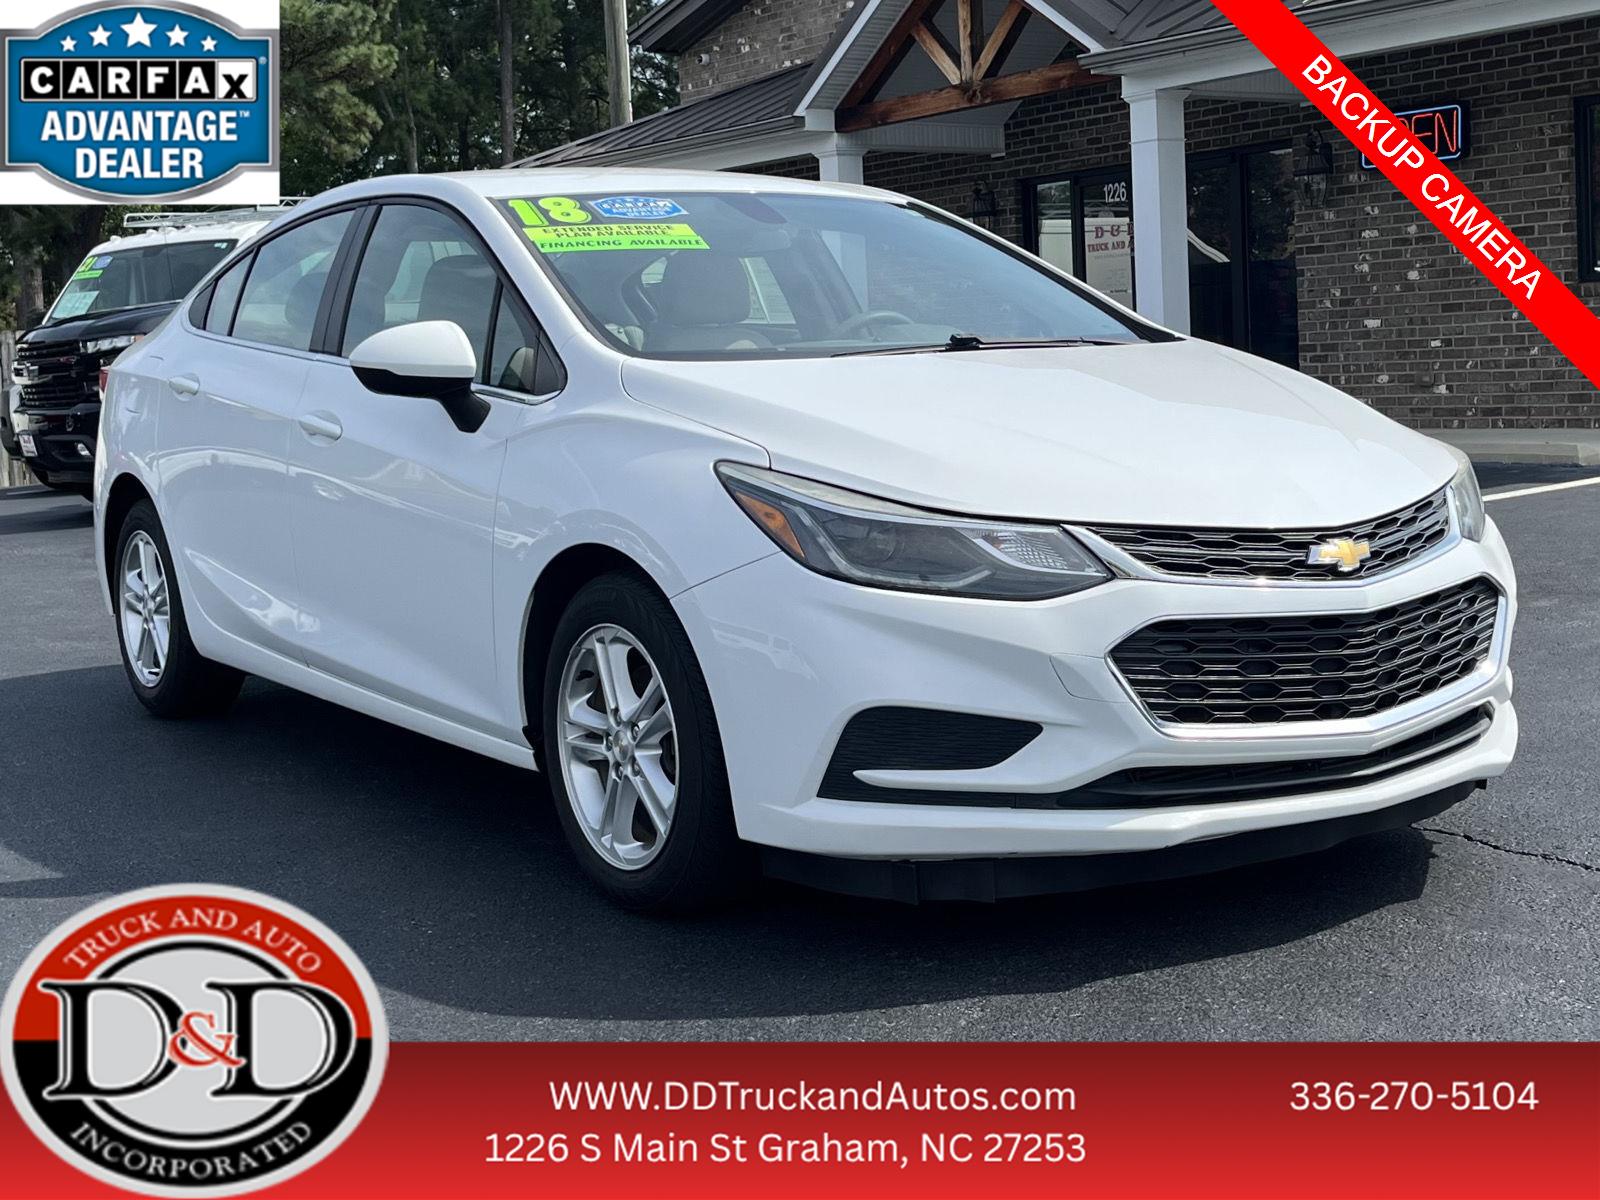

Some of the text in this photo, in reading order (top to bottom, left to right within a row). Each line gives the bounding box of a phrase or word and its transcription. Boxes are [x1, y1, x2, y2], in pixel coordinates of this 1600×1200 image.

[1103, 182, 1127, 203] 1226
[508, 197, 592, 226] 18
[541, 223, 674, 234] EXTENDED SERVICE
[597, 230, 672, 238] AVAILABLE
[540, 237, 704, 249] FINANCING AVAILABLE
[1087, 243, 1109, 253] TRUCK
